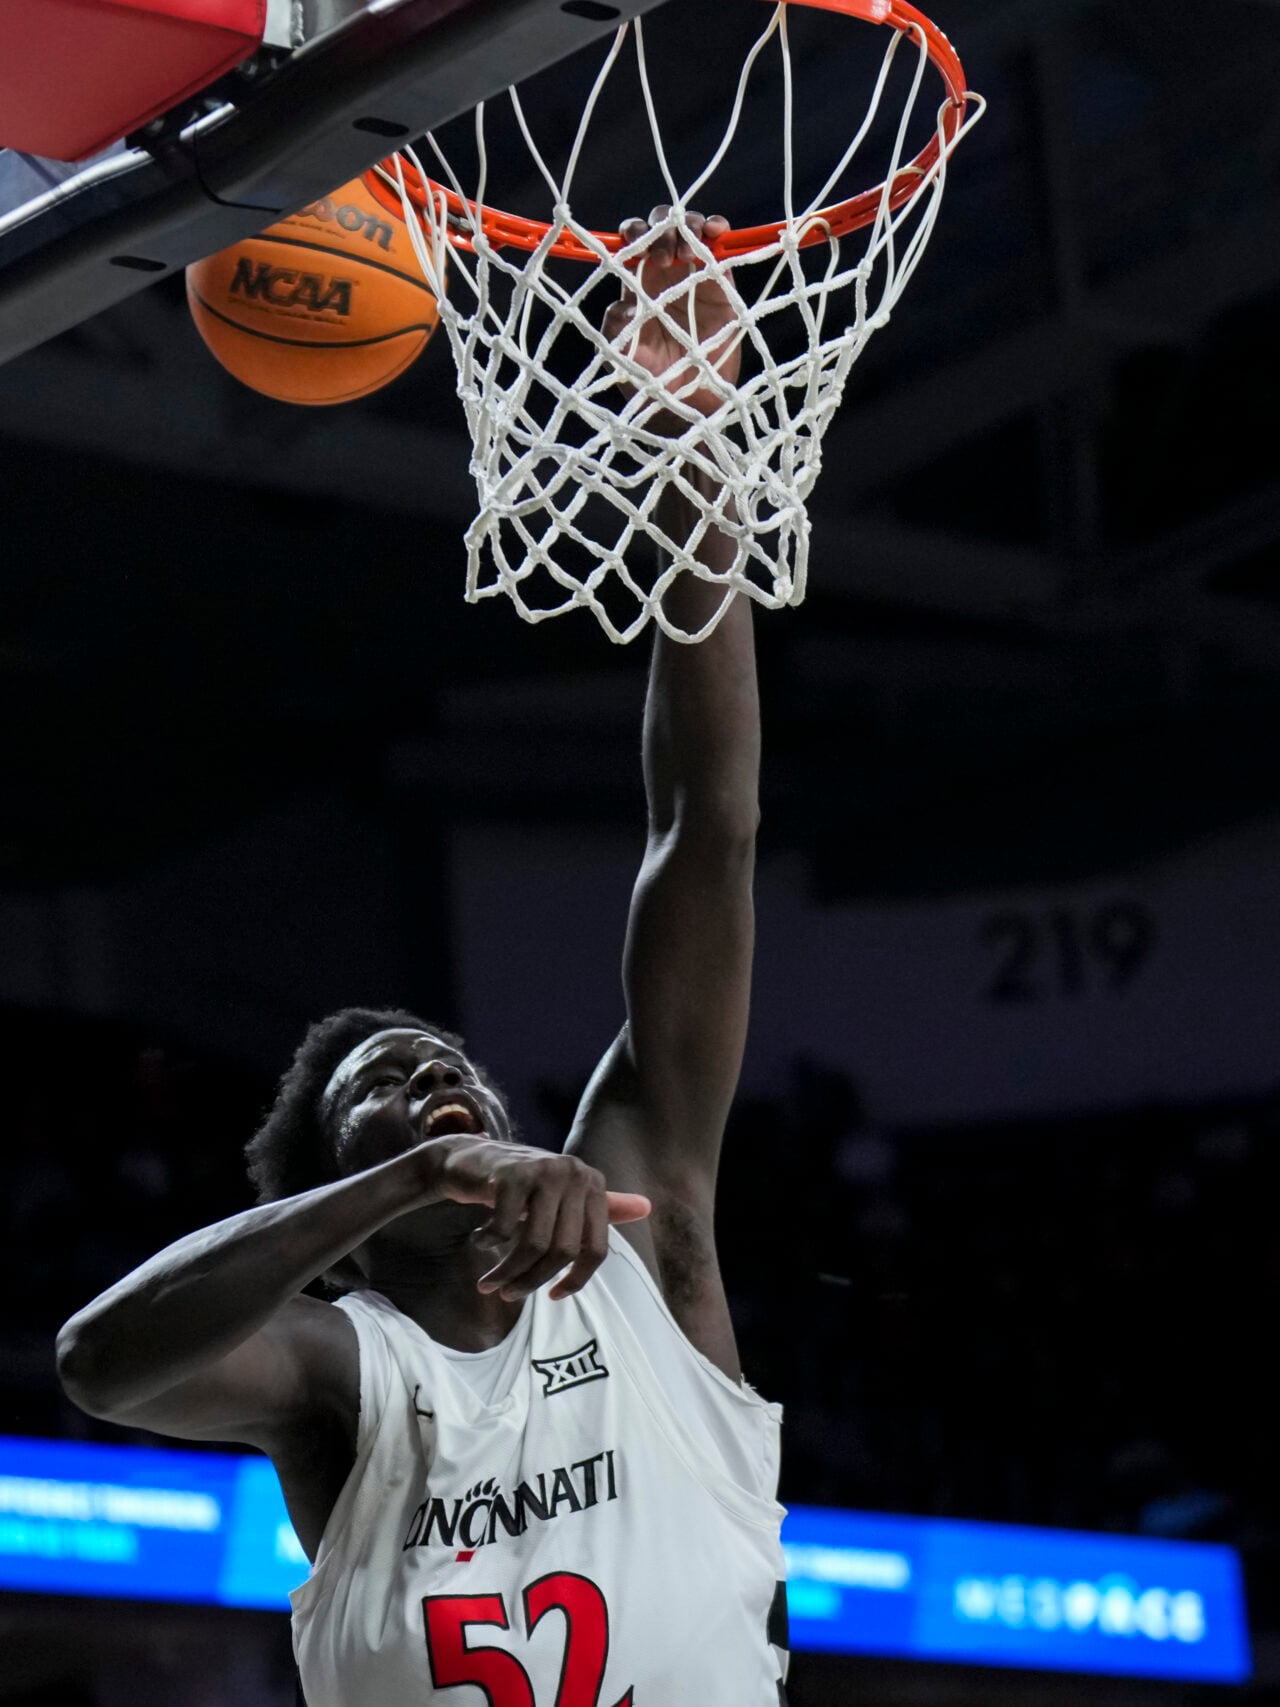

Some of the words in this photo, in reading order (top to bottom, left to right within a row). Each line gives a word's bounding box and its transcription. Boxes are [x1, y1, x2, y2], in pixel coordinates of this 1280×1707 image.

[228, 256, 354, 317] NCAA
[976, 902, 1156, 1004] 219
[531, 1337, 609, 1399] XII
[422, 1571, 634, 1707] 52
